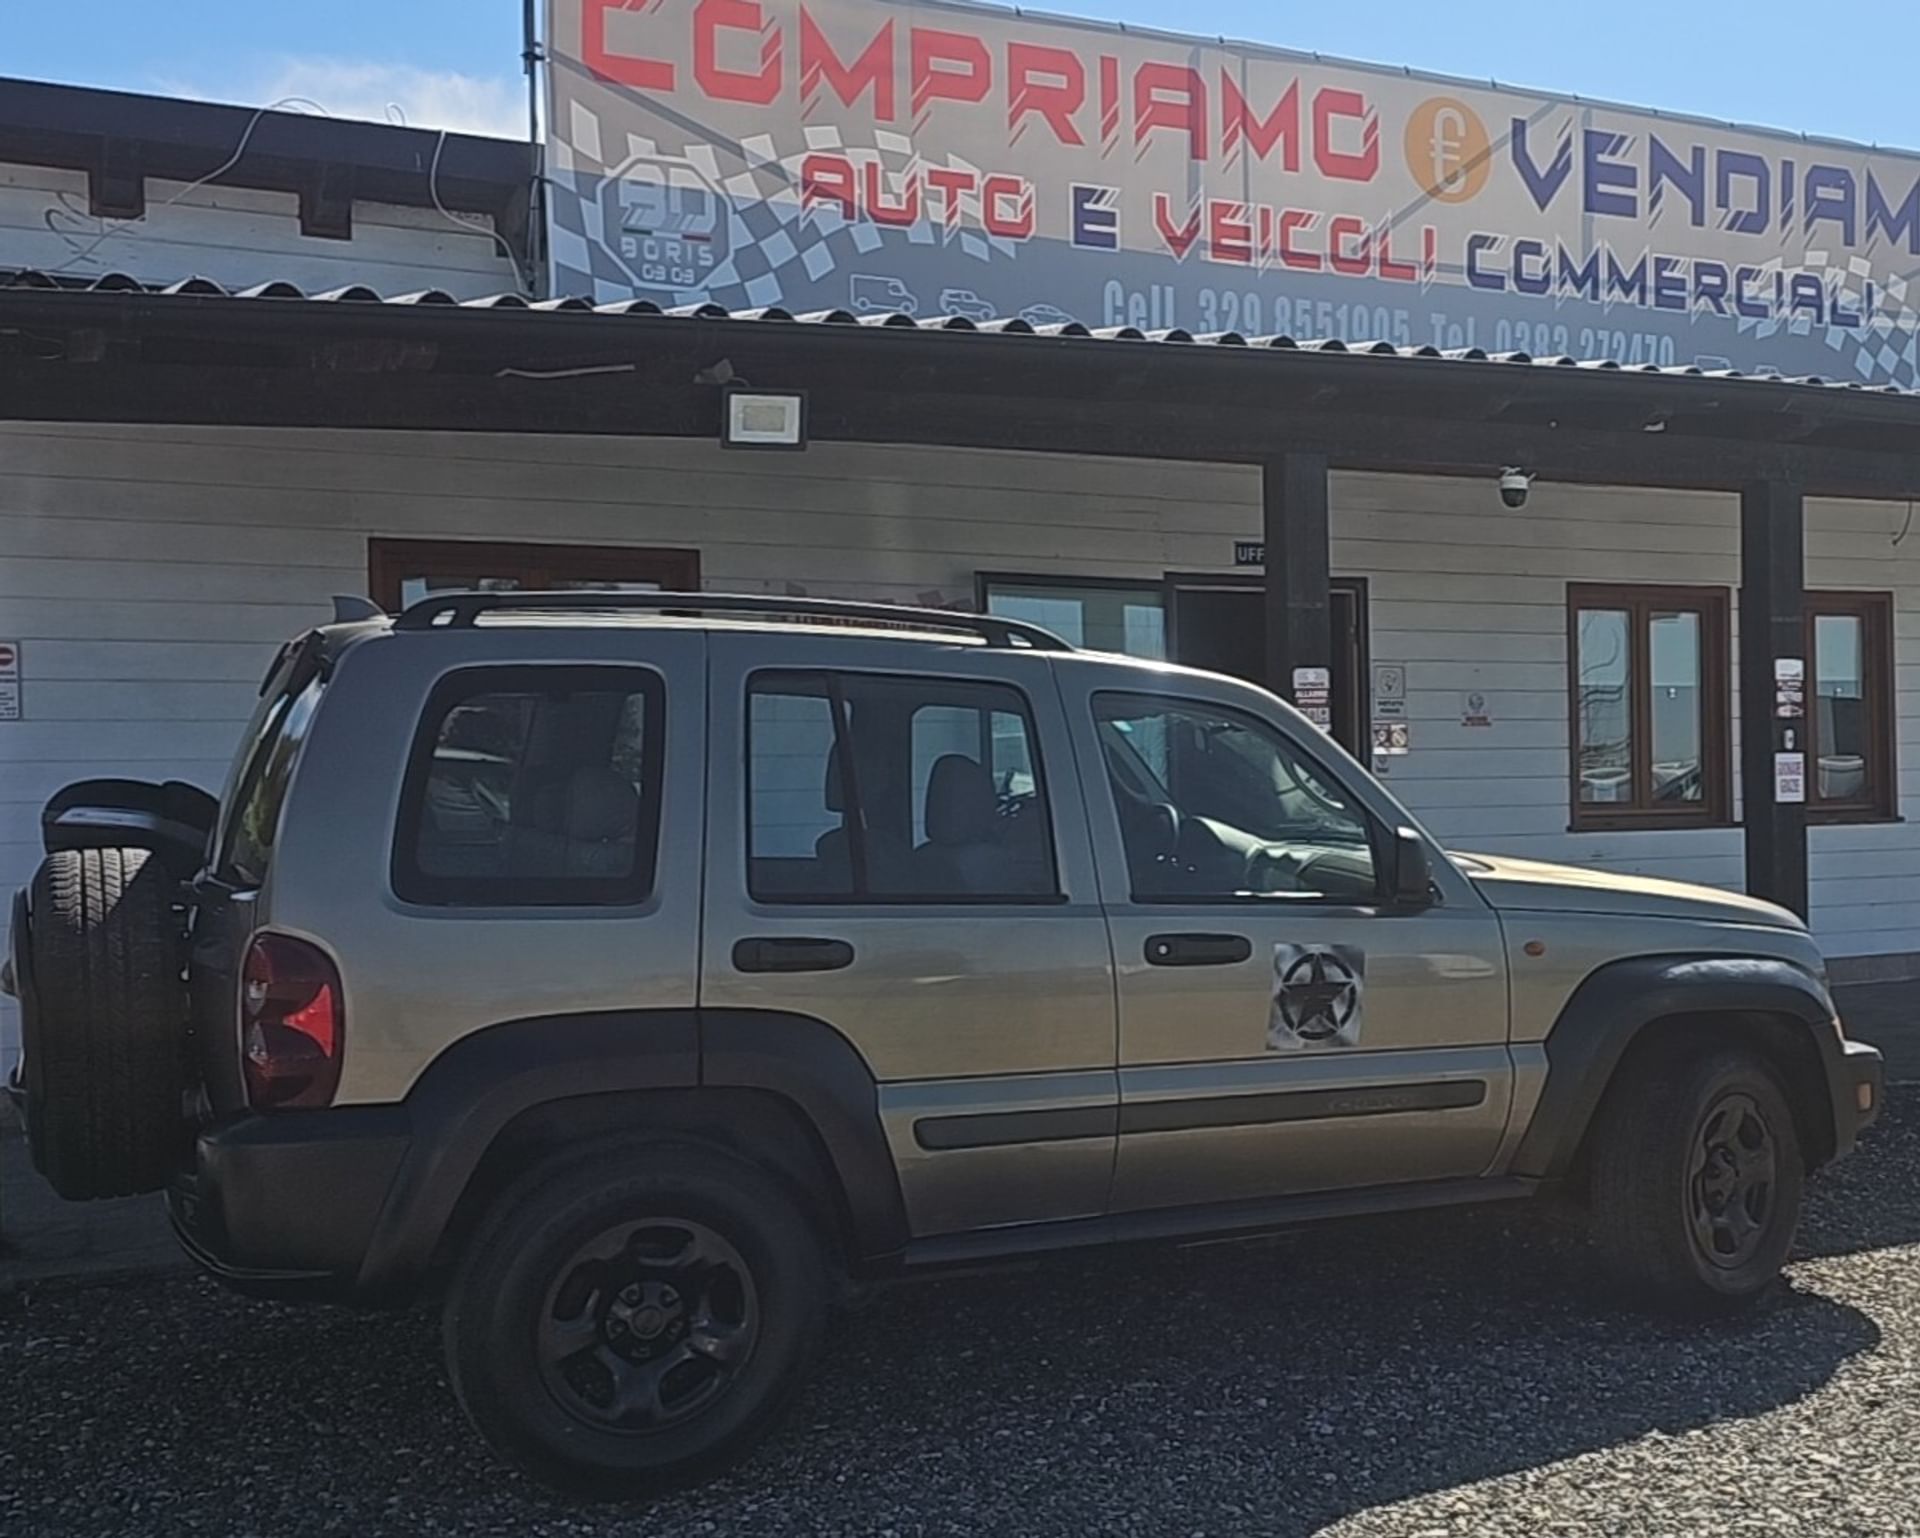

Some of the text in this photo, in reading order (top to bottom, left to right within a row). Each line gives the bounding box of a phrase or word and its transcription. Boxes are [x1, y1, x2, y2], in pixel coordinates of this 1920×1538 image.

[579, 0, 1380, 182] COMPRIAMO
[620, 236, 714, 267] BORIS
[800, 153, 1876, 331] AUTO E VEICOLI COMMERCIALI
[1198, 287, 1262, 335] 329
[1495, 319, 1569, 356] 0383
